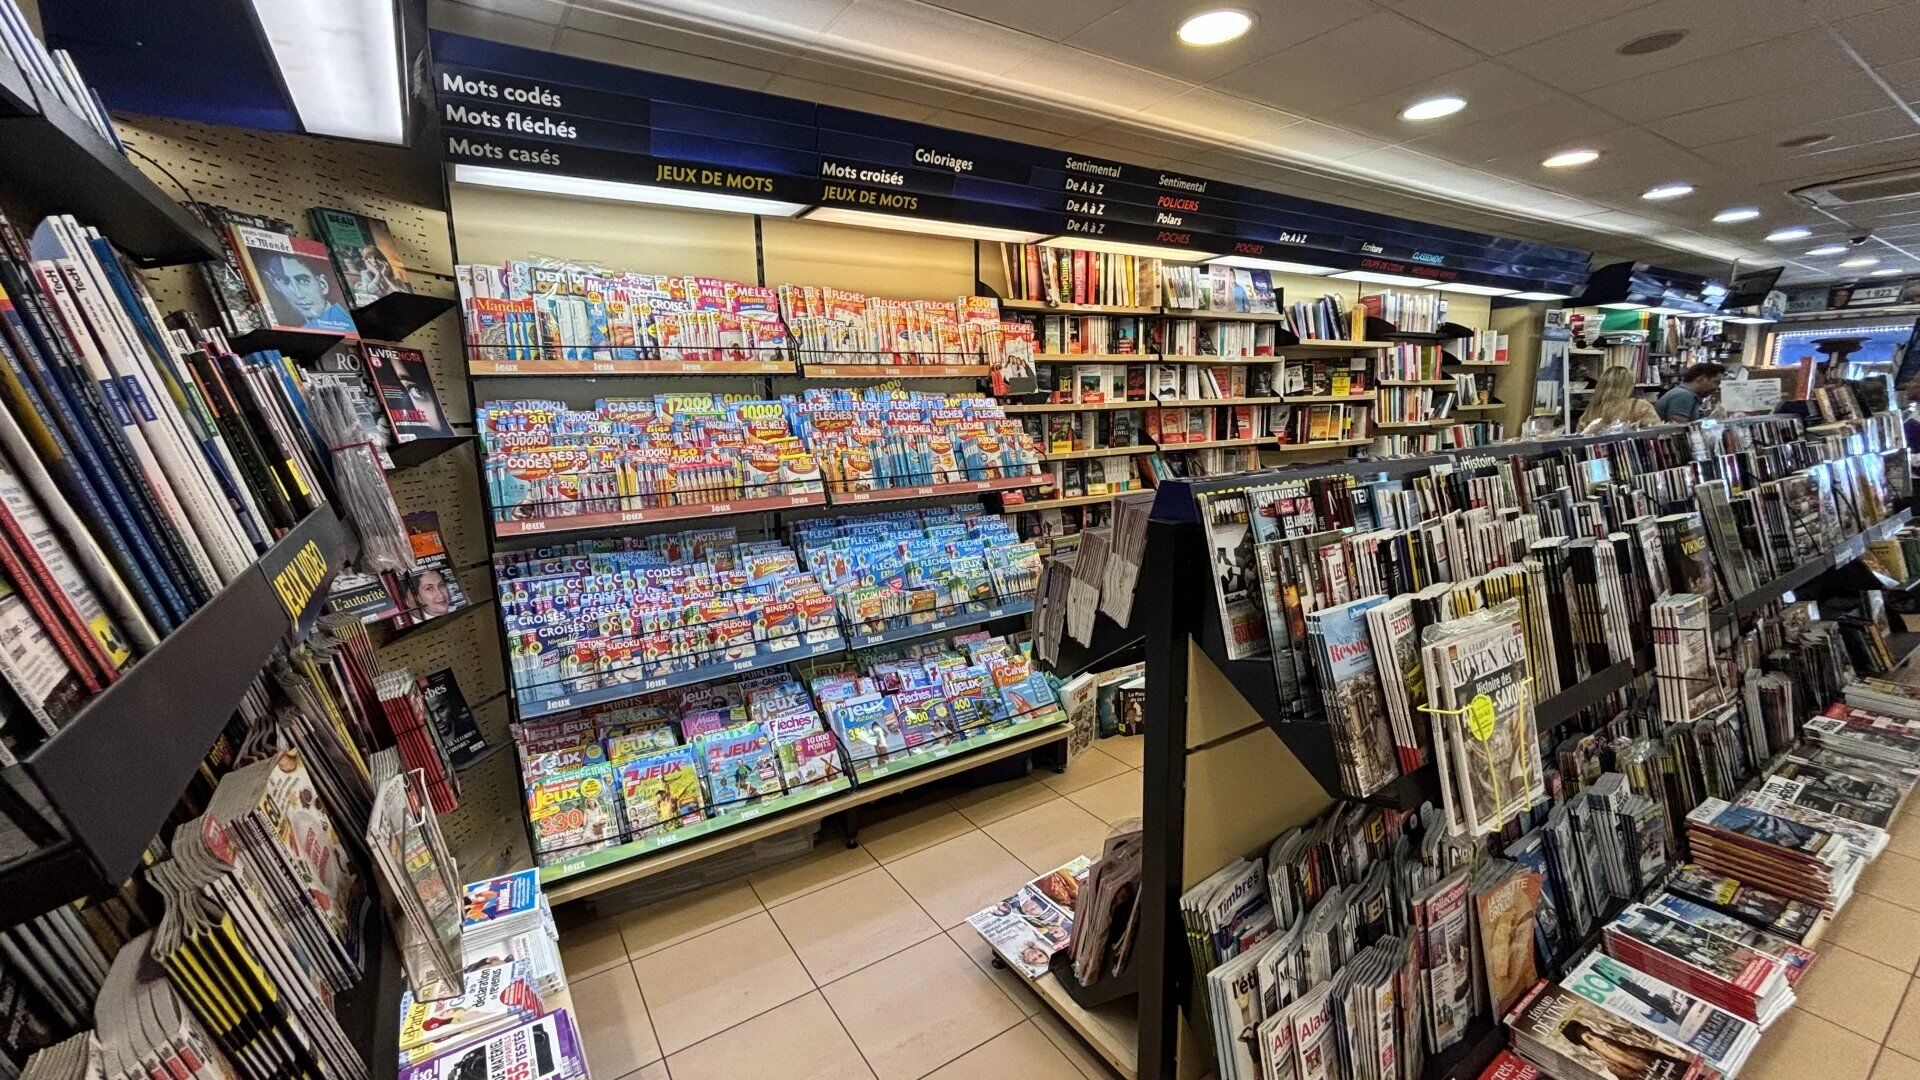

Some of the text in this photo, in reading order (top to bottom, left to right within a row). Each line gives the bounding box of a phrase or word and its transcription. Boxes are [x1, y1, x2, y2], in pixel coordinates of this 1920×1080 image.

[443, 73, 561, 107] Mots codés
[446, 104, 577, 139] Mots fléchés
[449, 137, 560, 166] Mots casés
[915, 149, 973, 171] Coloriages
[1065, 157, 1122, 178] Sentimental
[656, 164, 773, 192] JEUX DE MOTS
[822, 162, 904, 186] Mots croisés
[1065, 178, 1105, 195] De A à Z
[1158, 174, 1206, 193] Sentimental
[822, 185, 918, 210] JEUX DE MOTS
[1157, 196, 1199, 211] POLICIERS
[1066, 200, 1105, 215] De A à Z
[1066, 219, 1105, 234] De A à Z
[1157, 213, 1182, 226] Polars
[258, 238, 290, 252] Monde
[1157, 232, 1191, 244] POCHES
[1280, 232, 1290, 242] De
[1301, 235, 1308, 244] Z
[1235, 242, 1264, 255] POCHES
[495, 363, 518, 372] Jeux
[594, 363, 615, 371] Jeux
[1462, 454, 1497, 470] Histoire
[791, 497, 809, 505] Jeux
[622, 512, 644, 521] Jeux
[521, 521, 545, 531] Jeux
[647, 567, 683, 578] CODÉS
[330, 587, 386, 612] L'autorité
[519, 611, 566, 625] CROISÉS
[1391, 614, 1415, 636] HISTO
[539, 623, 585, 637] CROISÉS
[607, 640, 640, 650] SUDOKU
[733, 660, 753, 670] Jeux
[1451, 646, 1499, 687] MOYEN
[646, 678, 667, 689] Jeux
[1476, 671, 1512, 693] Histoire des
[547, 699, 571, 710] Jeux
[726, 739, 761, 756] JEUX
[807, 740, 831, 751] POINTS
[641, 761, 686, 779] JEUX
[533, 787, 581, 811] Jeux
[540, 809, 584, 836] 330
[656, 834, 677, 846] Jeux
[563, 860, 586, 874] Jeux
[1217, 868, 1260, 919] Timbres
[474, 969, 491, 1008] déclaration
[490, 969, 502, 995] revenus
[1547, 993, 1578, 1026] VINCI
[515, 1029, 525, 1064] TESTÉS
